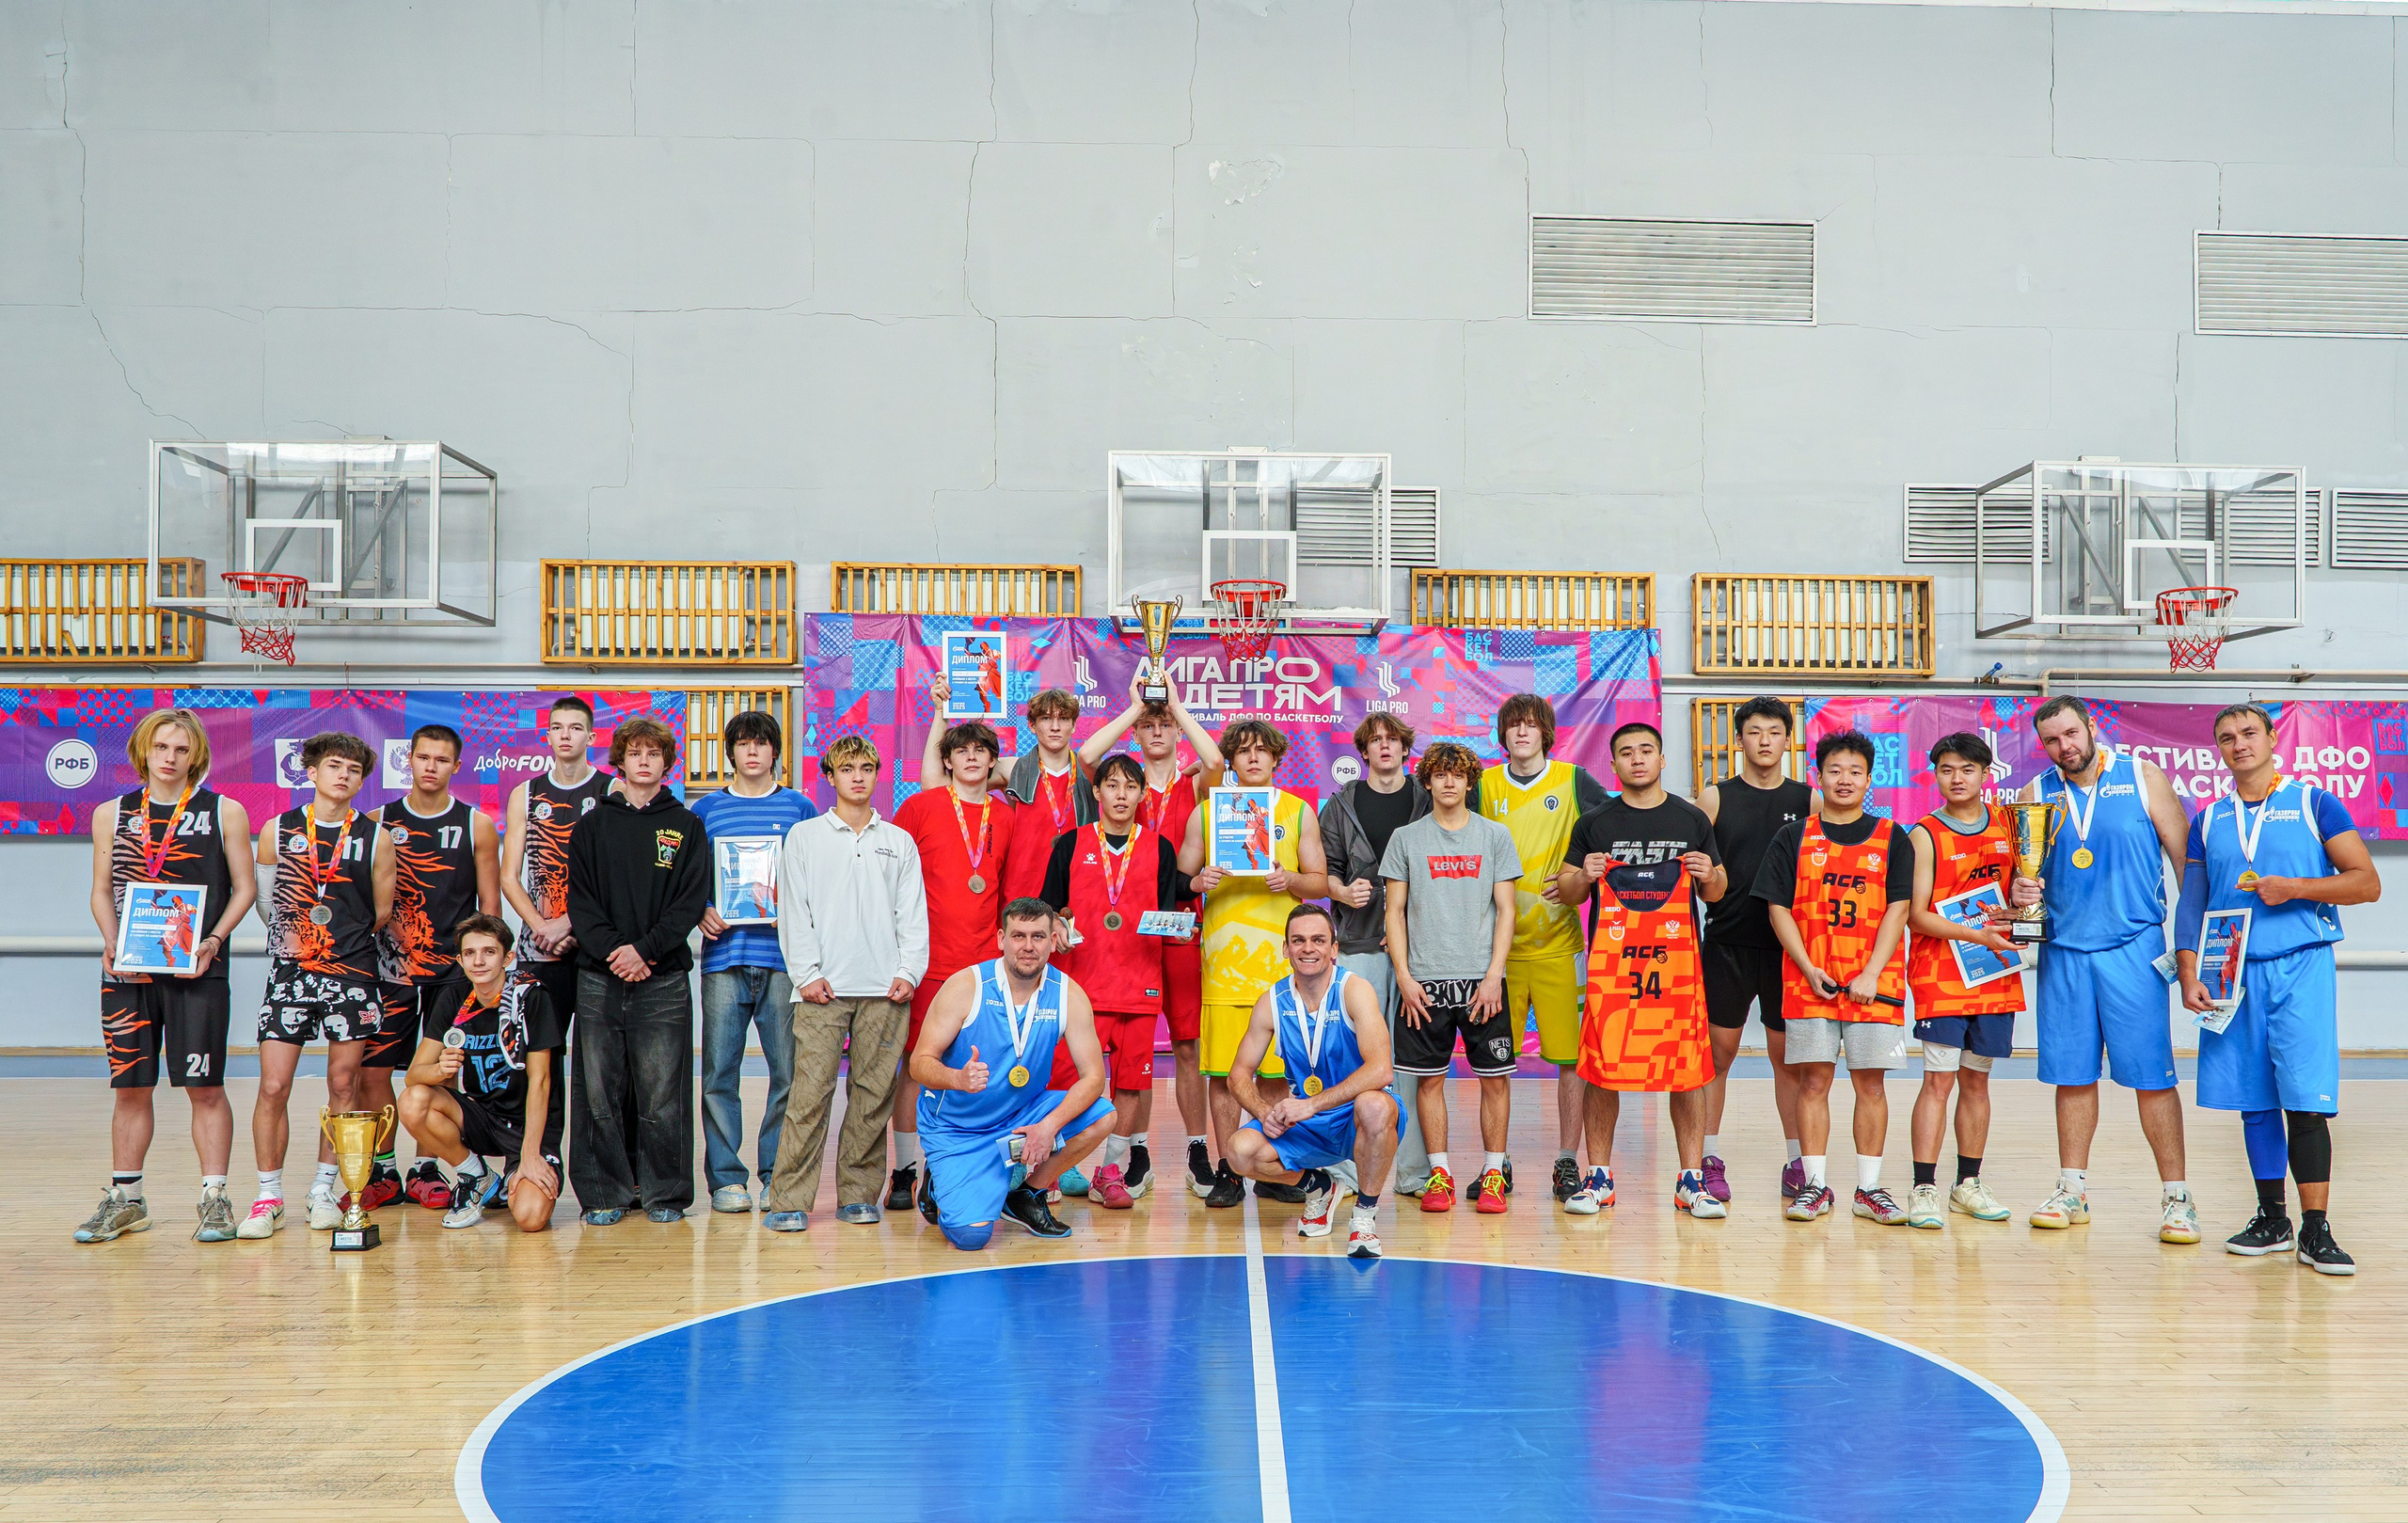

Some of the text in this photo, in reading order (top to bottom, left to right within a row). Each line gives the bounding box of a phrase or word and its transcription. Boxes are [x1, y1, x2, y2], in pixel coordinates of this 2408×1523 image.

[1465, 631, 1493, 643] БАС
[1465, 642, 1492, 653] КЕТ
[952, 655, 988, 665] ДИПЛОМ
[1465, 652, 1494, 661] БОЛ
[1229, 657, 1321, 683] ПРО
[1086, 695, 1106, 707] PRO
[1180, 683, 1342, 711] ДЕТЯМ
[1366, 700, 1408, 714] LIGA PRO
[1190, 712, 1344, 723] ИВАЛЬ ДФО ПО БАСКЕТБОЛУ
[2377, 722, 2402, 733] БАС
[1873, 736, 1900, 753] АС
[2379, 740, 2406, 752] БОЛ
[55, 756, 89, 770] РФБ
[1873, 753, 1898, 769] ЕТ
[2096, 741, 2370, 771] ЕСТИВАЬ ДФО
[1336, 767, 1356, 775] РФБ
[1871, 769, 1903, 785] ОЛ
[2171, 773, 2367, 799] АСКОЛУ
[1979, 788, 1993, 802] GA
[1493, 798, 1509, 817] 14
[178, 811, 212, 836] 24
[1218, 813, 1256, 823] ДИПЛОМ
[437, 825, 463, 849] 17
[341, 835, 364, 862] 11
[1615, 891, 1645, 900] АСКЕТБОЛ
[133, 907, 180, 918] ДИПЛОМ
[1828, 898, 1858, 928] 33
[1957, 912, 1990, 928] ИПЛОМ
[2206, 937, 2233, 949] ДИПЛОМ
[1622, 944, 1668, 961] АСБ
[1628, 971, 1662, 1000] 34
[464, 1033, 501, 1050] RIZZ
[1490, 1038, 1511, 1051] NETS
[186, 1053, 210, 1077] 24
[470, 1054, 513, 1093] 12
